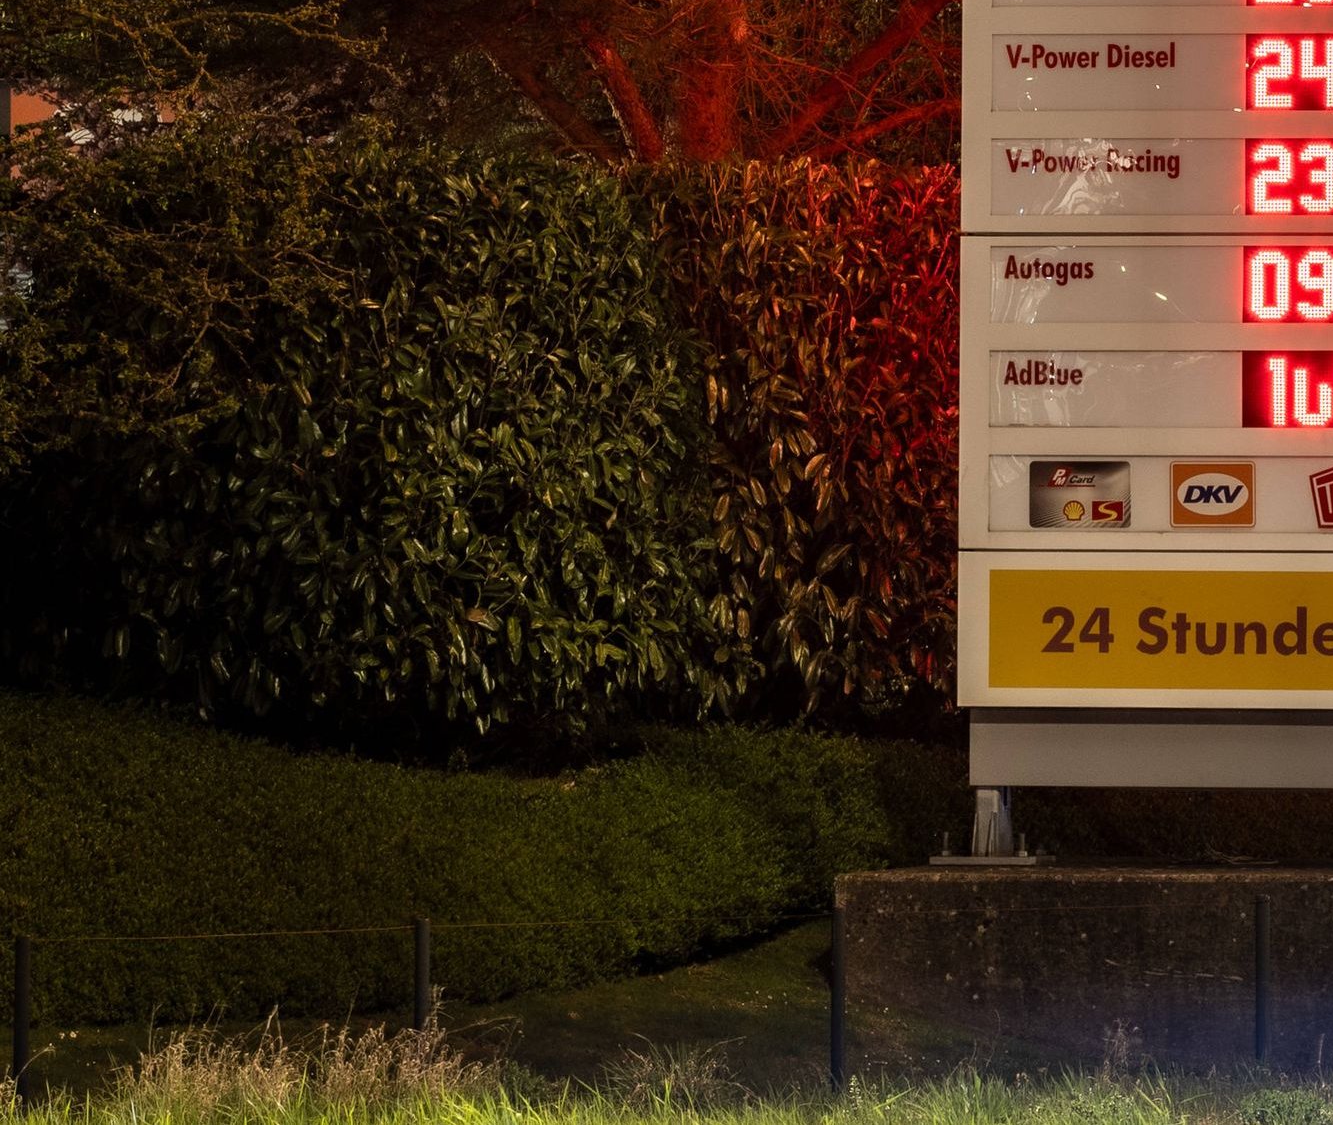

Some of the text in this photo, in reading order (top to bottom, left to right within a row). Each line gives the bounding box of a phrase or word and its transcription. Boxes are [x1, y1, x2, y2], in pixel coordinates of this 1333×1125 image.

[1006, 41, 1176, 69] V-Power Diesel
[1004, 254, 1094, 286] Autogas
[1004, 360, 1083, 386] AdBlue
[1069, 475, 1095, 484] Card
[1183, 485, 1244, 504] DKV
[1041, 606, 1115, 654] 24
